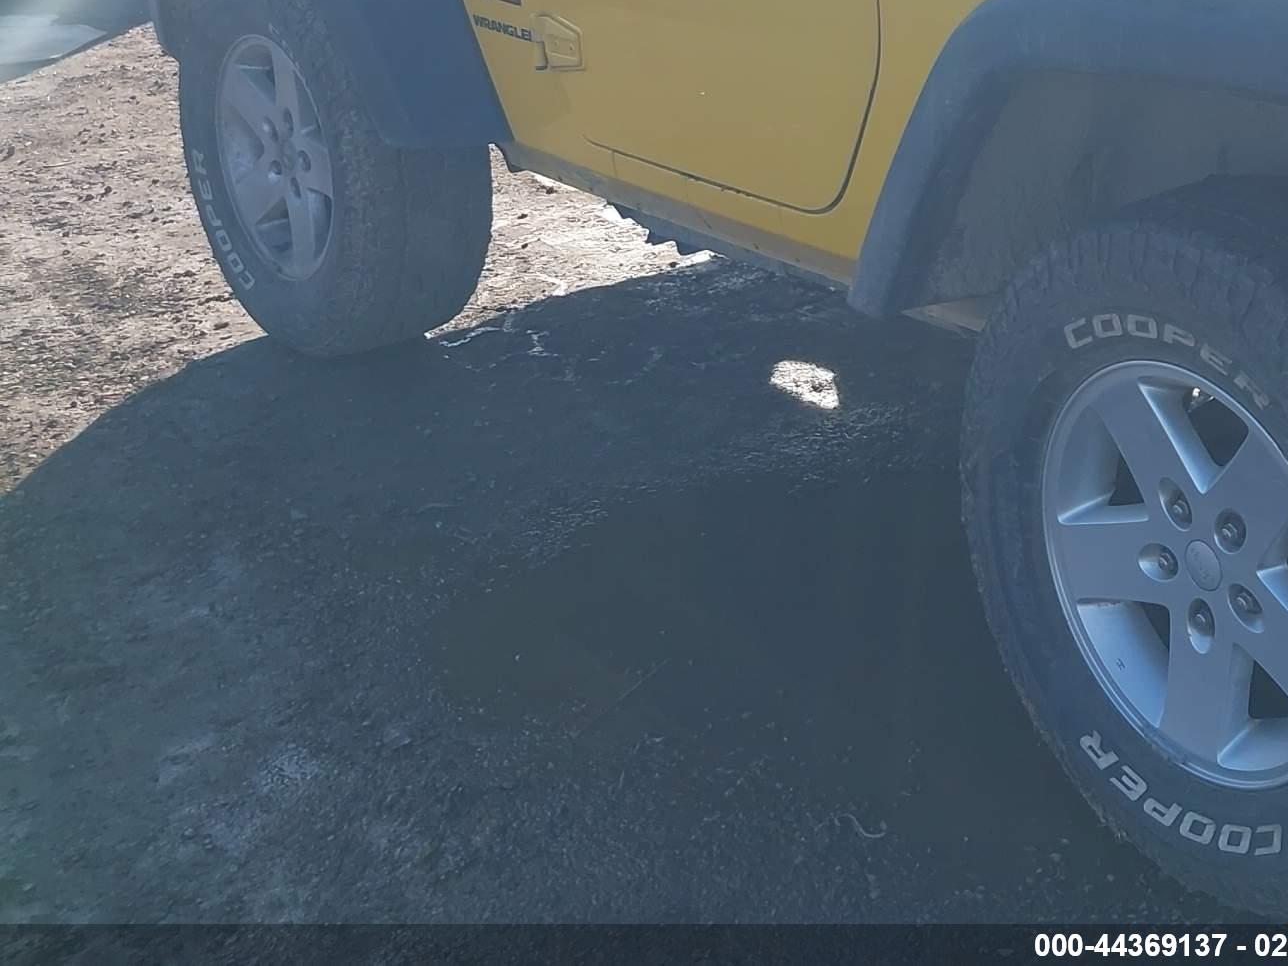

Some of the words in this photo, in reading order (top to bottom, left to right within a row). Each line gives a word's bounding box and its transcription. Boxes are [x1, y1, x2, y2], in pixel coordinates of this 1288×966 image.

[191, 148, 255, 291] COOPER
[1063, 312, 1271, 411] COOPER
[1079, 729, 1283, 856] COOPER
